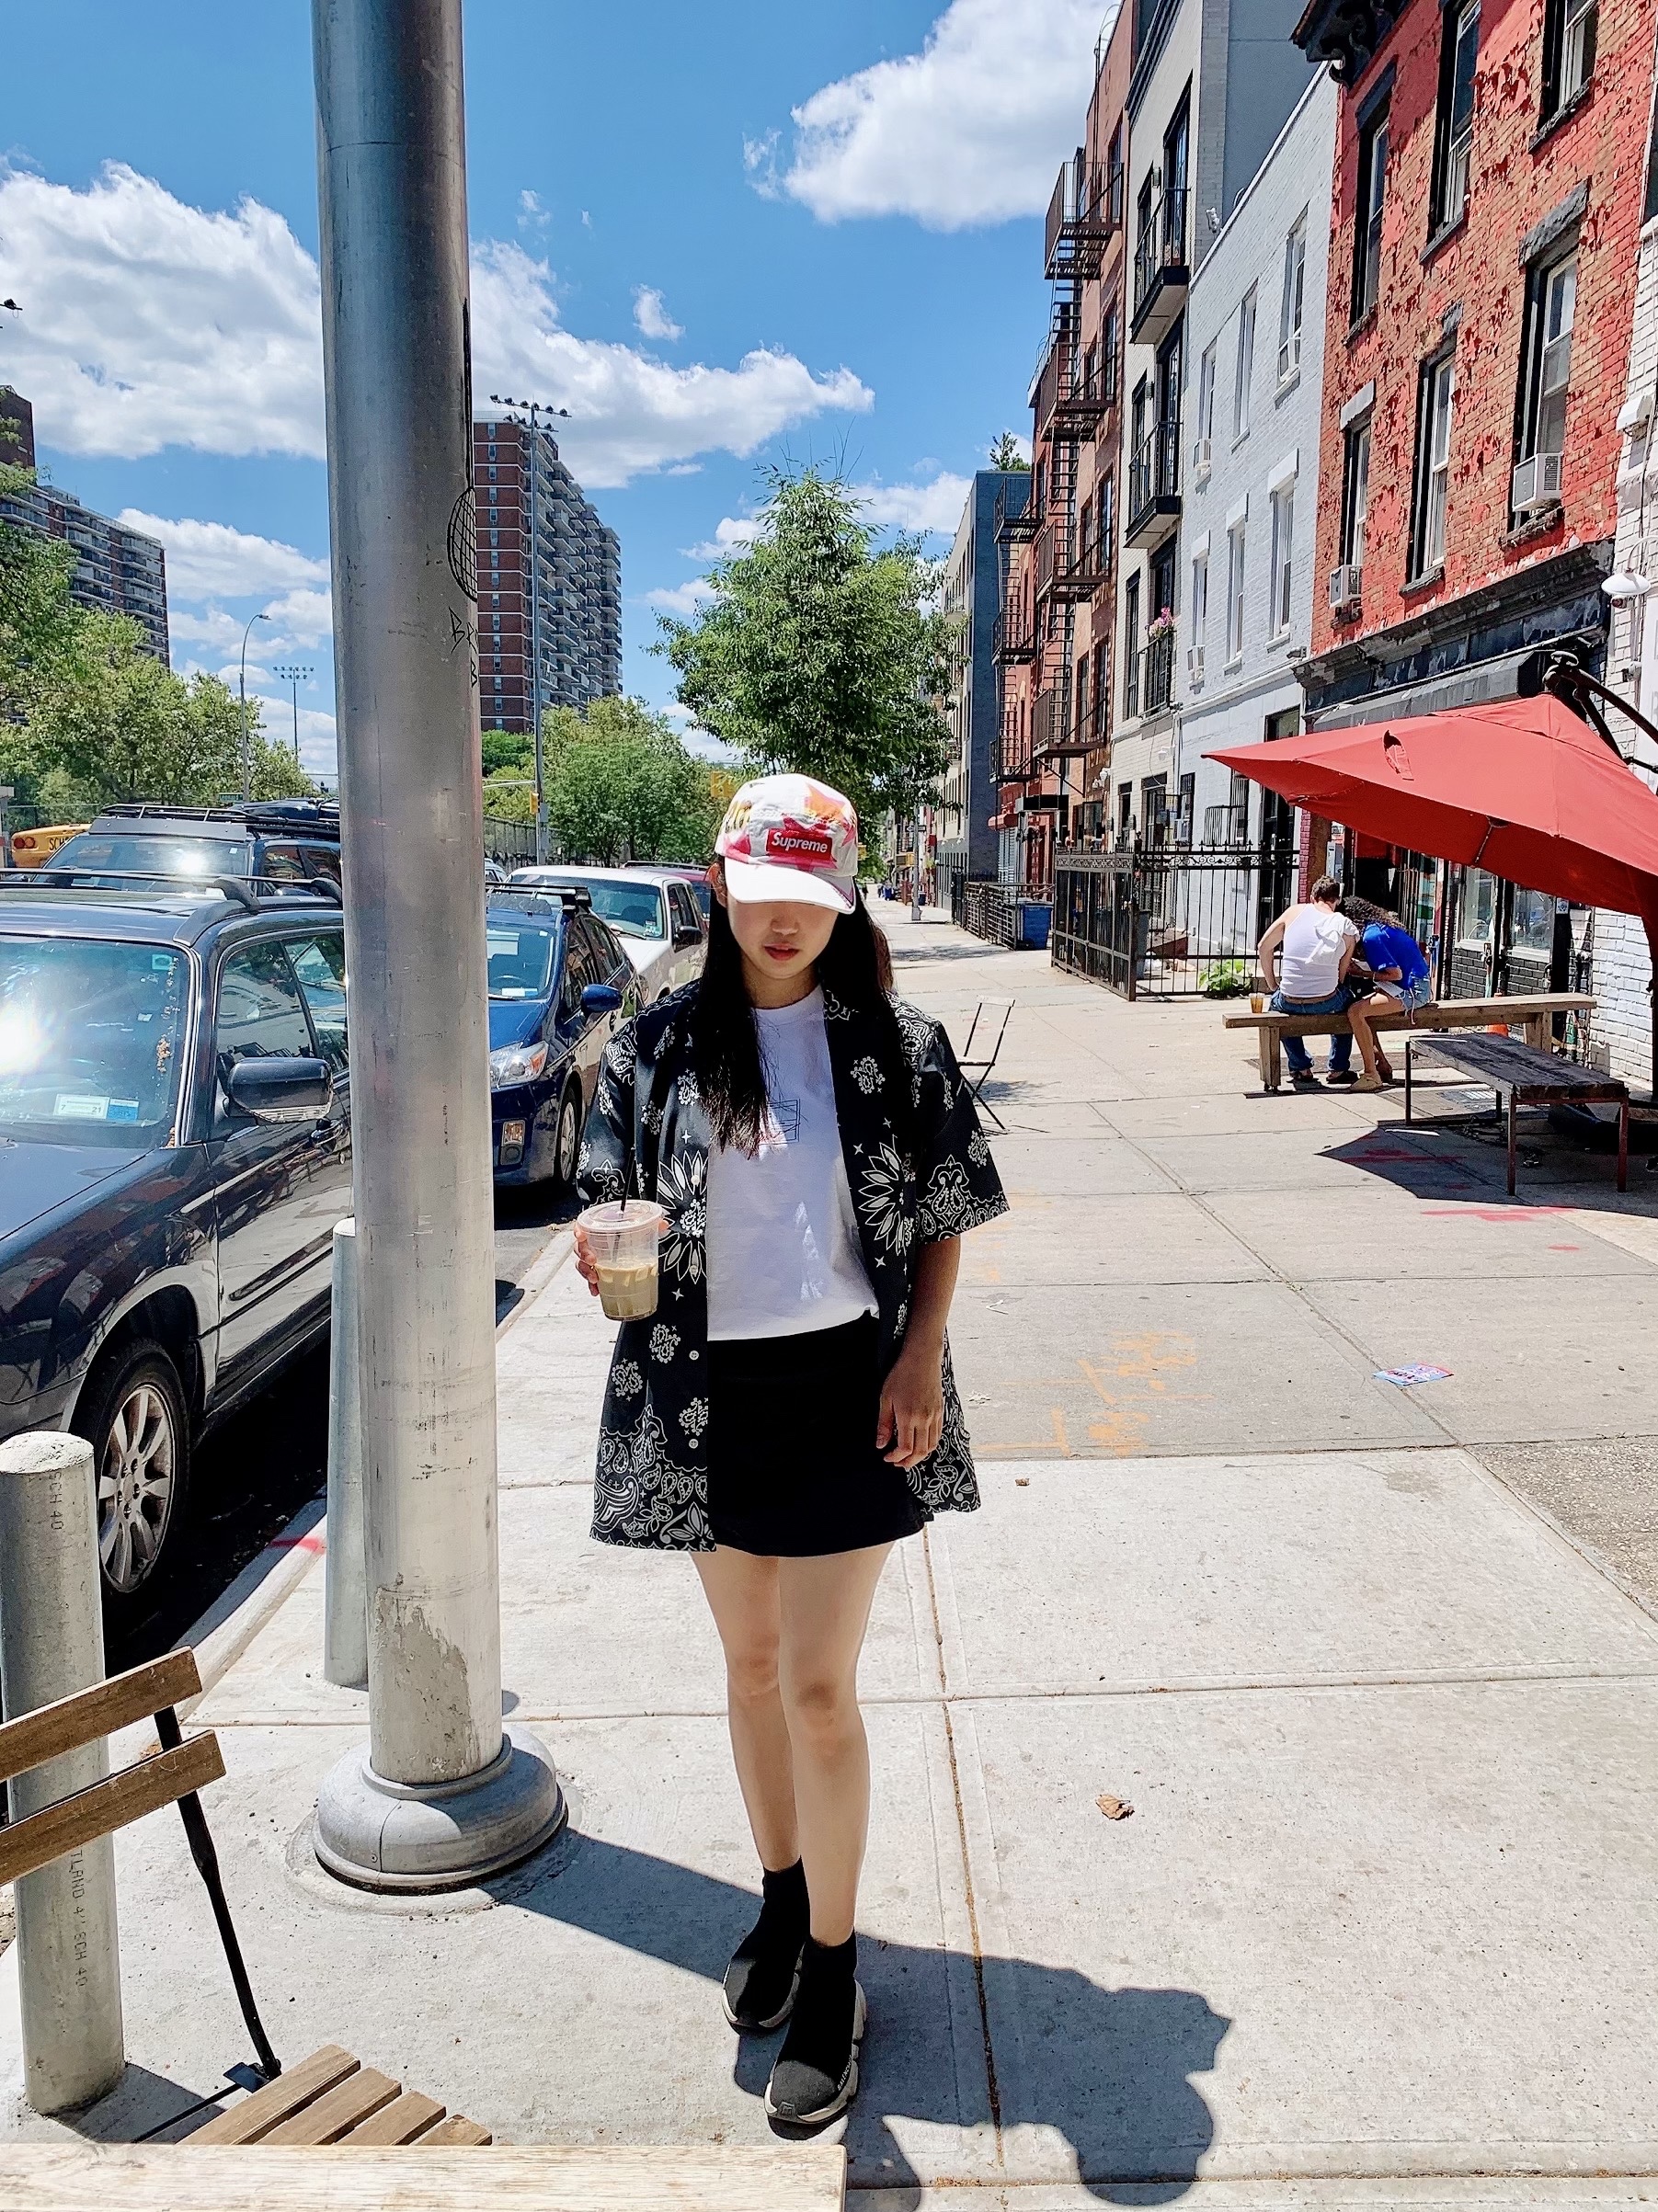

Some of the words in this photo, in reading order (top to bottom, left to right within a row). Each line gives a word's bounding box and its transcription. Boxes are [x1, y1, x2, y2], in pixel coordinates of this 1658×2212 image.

[771, 831, 829, 853] Supreme
[50, 1511, 64, 1530] 40
[74, 1931, 87, 1961] SCH
[74, 1967, 88, 1987] 40
